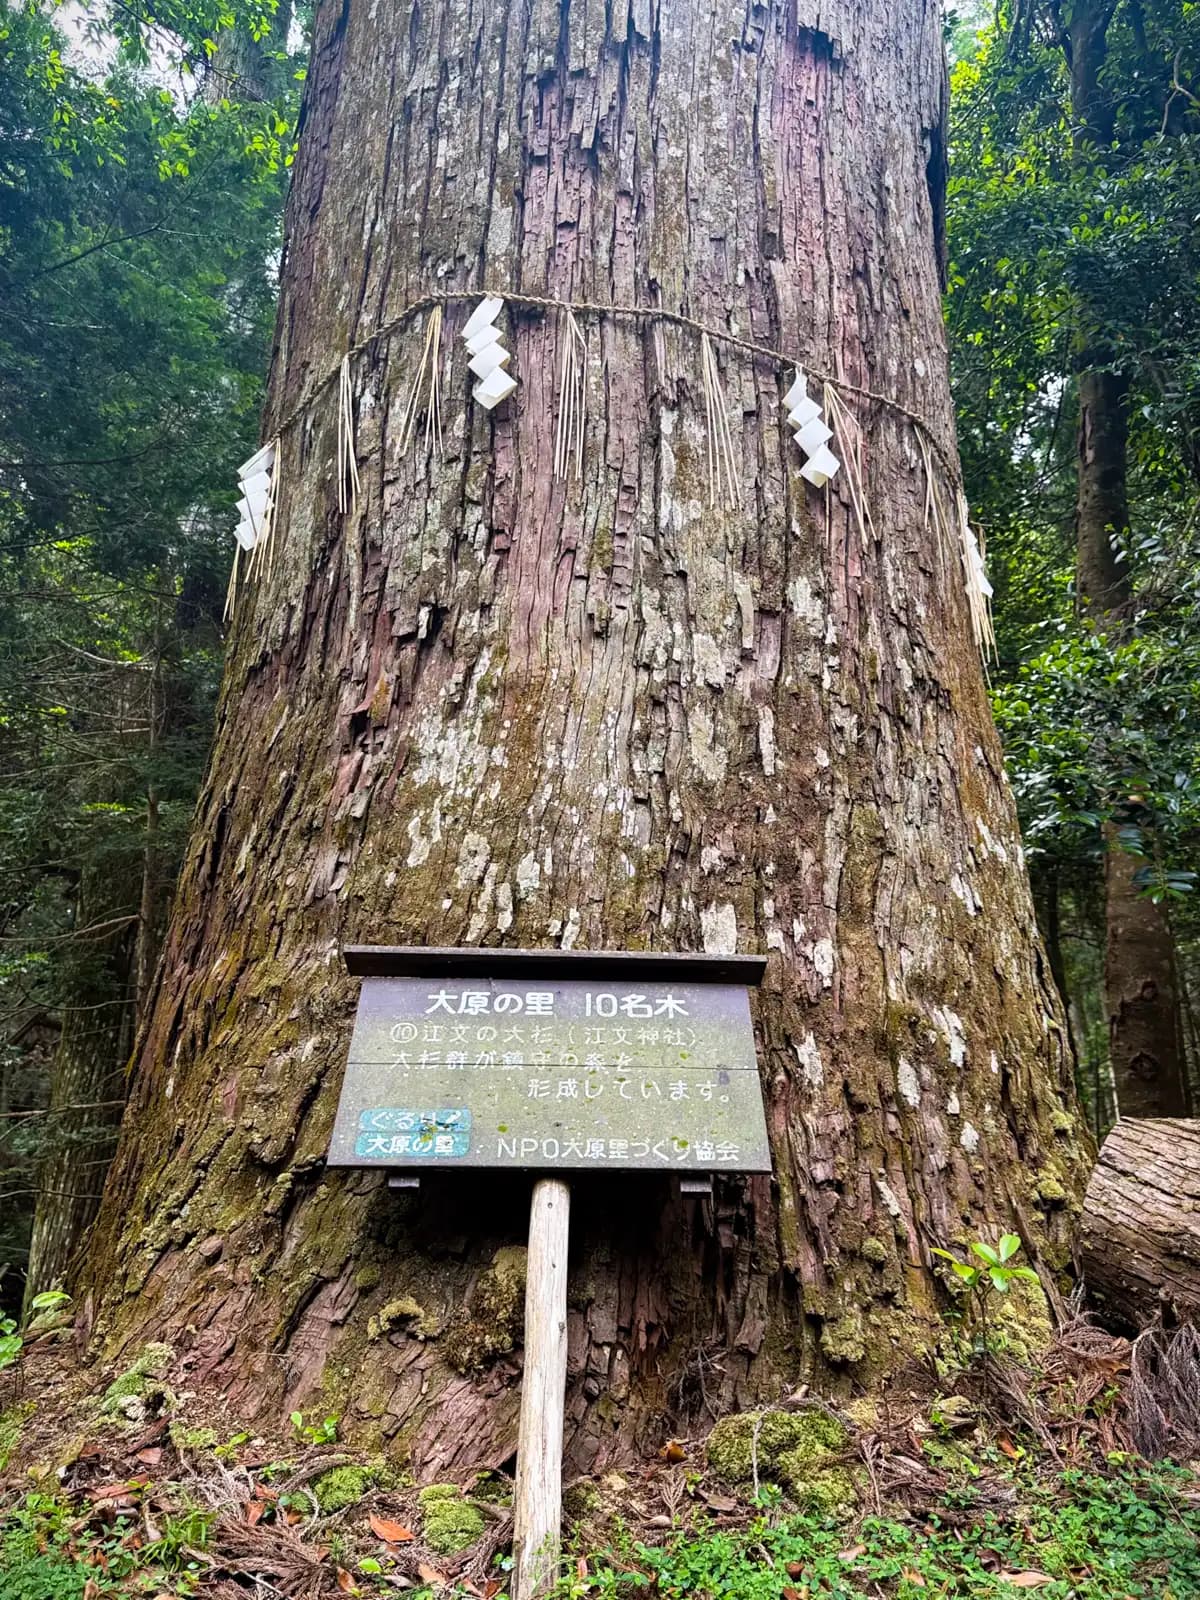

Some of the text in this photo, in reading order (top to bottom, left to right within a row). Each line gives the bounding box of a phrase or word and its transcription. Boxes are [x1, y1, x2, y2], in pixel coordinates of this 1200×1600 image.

[425, 990, 689, 1018] 大原の里 10名木
[527, 1077, 730, 1102] 形成しています。
[365, 1134, 454, 1153] 大原の里
